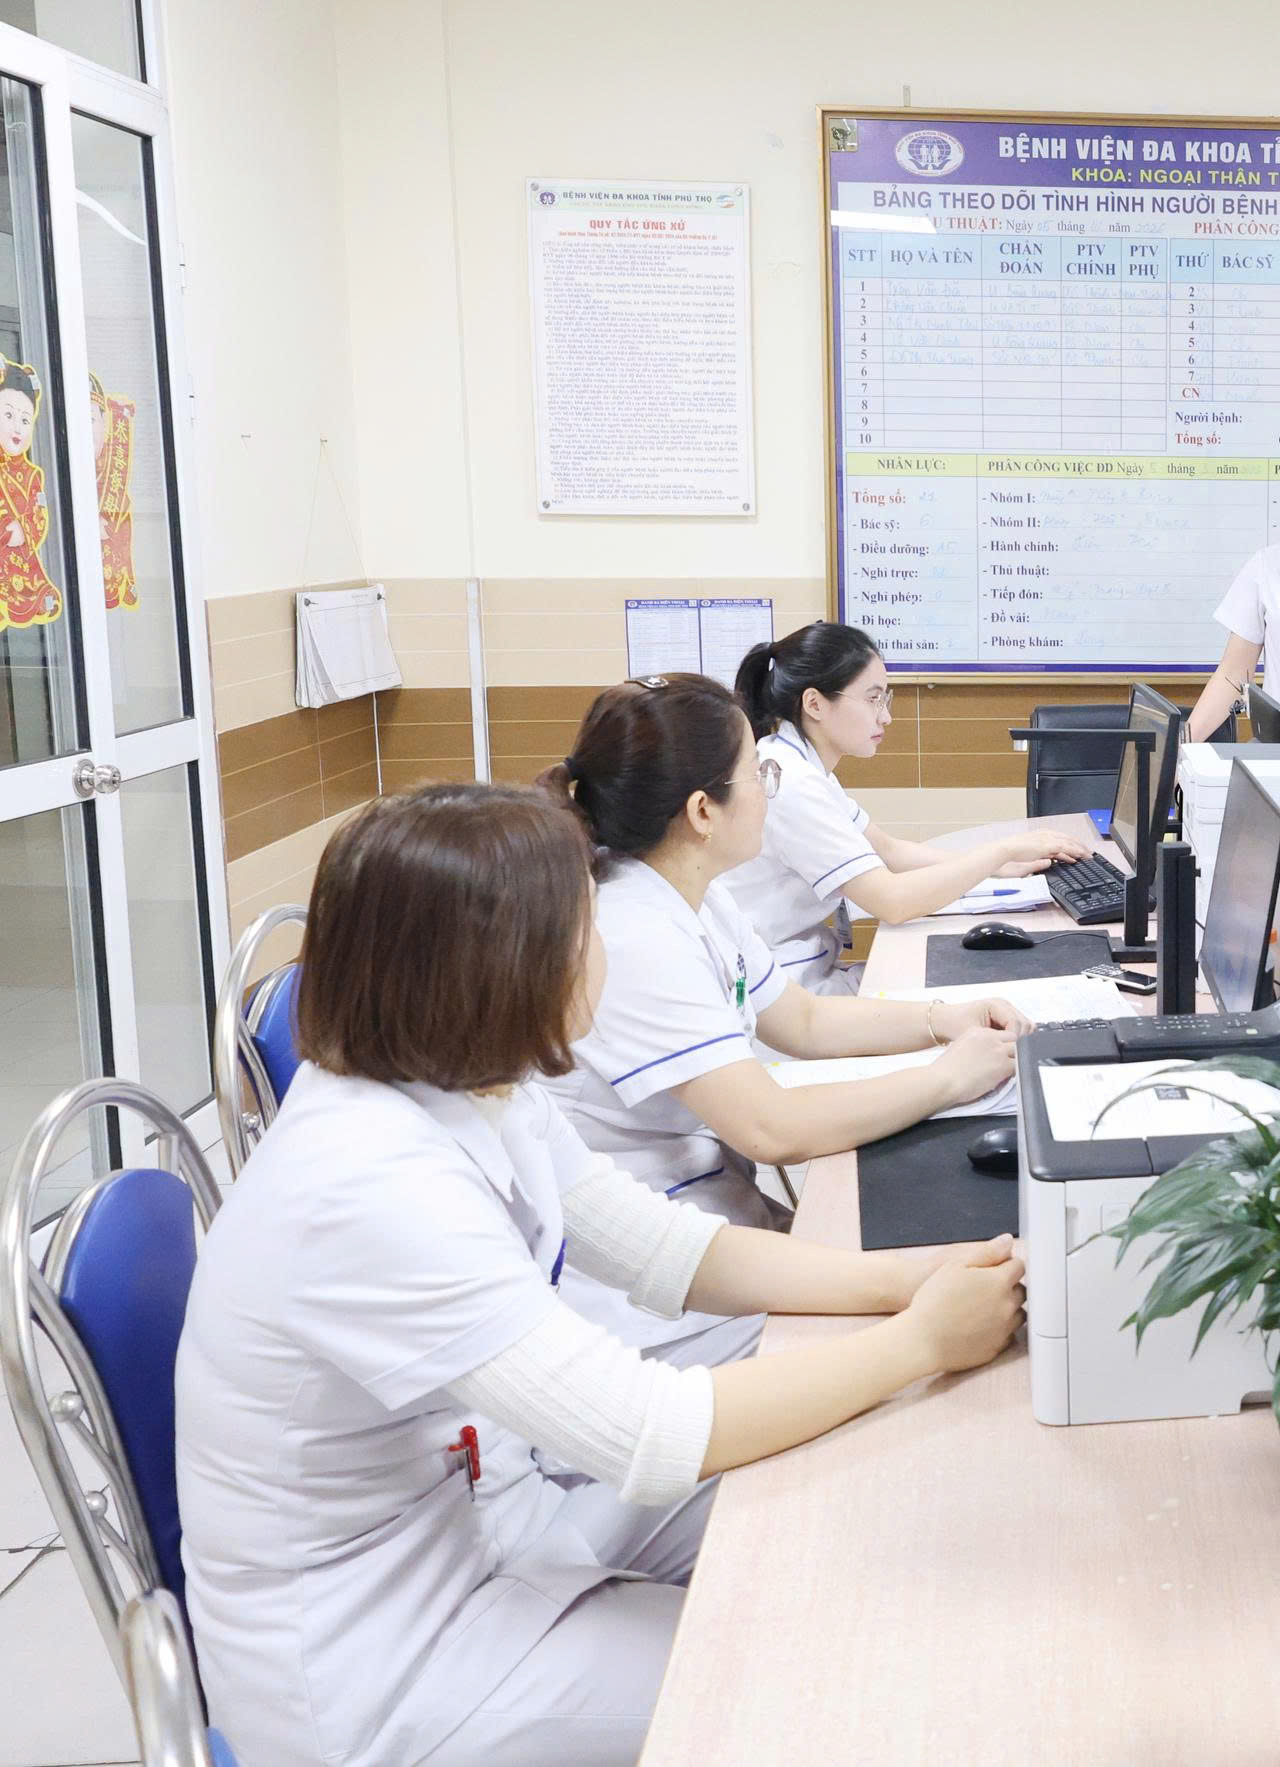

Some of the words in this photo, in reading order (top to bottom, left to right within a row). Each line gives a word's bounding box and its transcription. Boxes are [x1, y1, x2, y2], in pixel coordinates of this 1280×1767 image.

[999, 133, 1067, 164] BỆNH
[1076, 134, 1134, 165] VIỆN
[1142, 140, 1176, 161] ĐA
[1186, 141, 1253, 164] KHOA
[1071, 167, 1133, 183] KHOA:
[1139, 168, 1201, 186] NGOẠI
[1208, 168, 1261, 188] THẬN
[563, 191, 587, 201] BỆNH
[589, 192, 609, 201] VIỆN
[627, 194, 650, 202] KHOA
[696, 195, 713, 204] THỌ
[873, 184, 932, 210] BẢNG
[939, 191, 995, 210] THEO
[1001, 189, 1036, 211] DÕI
[1042, 190, 1089, 212] TÌNH
[1096, 190, 1144, 213] HÌNH
[1151, 193, 1215, 214] NGƯỜI
[1222, 194, 1278, 218] BỆNH
[589, 220, 612, 229] QUY
[642, 218, 666, 231] ỨNG
[670, 219, 687, 231] XỬ
[1006, 220, 1034, 233] Ngày
[1057, 220, 1086, 235] tháng
[1108, 222, 1131, 233] năm
[1194, 221, 1233, 235] PHÂN
[1237, 221, 1279, 236] CÔNG
[848, 248, 878, 262] STT
[890, 250, 913, 264] HỌ
[917, 247, 938, 263] VÀ
[944, 247, 974, 264] TÊN
[1077, 244, 1106, 257] PTV
[1130, 244, 1159, 257] PTV
[1000, 258, 1043, 275] ĐOÁN
[1176, 252, 1210, 268] THỨ
[1222, 252, 1254, 269] BÁC
[1256, 253, 1275, 270] SỸ
[1066, 259, 1116, 276] CHÍNH
[1129, 262, 1160, 279] PHỤ
[860, 281, 866, 291] 1
[1188, 286, 1195, 297] 2
[860, 298, 867, 309] 2
[1188, 303, 1195, 314] 3
[861, 315, 867, 326] 3
[1188, 320, 1195, 331] 4
[860, 332, 867, 343] 4
[1188, 337, 1195, 348] 5
[861, 349, 868, 360] 5
[1188, 354, 1195, 365] 6
[861, 366, 868, 377] 6
[1188, 371, 1195, 381] 7
[861, 383, 868, 393] 7
[1182, 387, 1200, 399] CN
[861, 400, 868, 410] 8
[861, 417, 868, 427] 9
[1175, 411, 1209, 426] Người
[1212, 411, 1243, 426] bệnh:
[859, 434, 872, 445] 10
[1174, 432, 1203, 447] Tổng
[1204, 432, 1222, 446] số:
[877, 458, 914, 471] NHÂN
[916, 459, 947, 473] LỰC:
[988, 459, 1023, 472] PHÂN
[1025, 460, 1061, 473] CÔNG
[1064, 461, 1095, 475] VIỆC
[1096, 463, 1115, 474] ĐD
[1117, 463, 1144, 477] Ngày
[1167, 462, 1196, 478] tháng
[1216, 464, 1239, 475] năm
[852, 489, 886, 507] Tổng
[888, 488, 907, 505] số:
[990, 491, 1024, 504] Nhóm
[1027, 493, 1036, 504] I:
[861, 518, 882, 531] Bác
[884, 519, 901, 533] sỹ:
[990, 515, 1024, 529] Nhóm
[1028, 517, 1041, 528] II:
[861, 541, 887, 555] Điều
[890, 543, 930, 557] dưỡng:
[990, 539, 1021, 553] Hành
[1024, 540, 1059, 553] chính:
[861, 567, 888, 581] Nghỉ
[891, 569, 919, 581] trực:
[991, 564, 1014, 577] Thủ
[1018, 564, 1050, 578] thuật:
[861, 591, 888, 605] Nghỉ
[891, 591, 923, 606] phép:
[990, 587, 1016, 602] Tiếp
[1019, 588, 1043, 600] đón:
[861, 615, 875, 626] Đi
[878, 615, 901, 628] học:
[991, 609, 1007, 623] Đồ
[1010, 611, 1030, 624] vải:
[891, 639, 913, 650] thai
[916, 639, 939, 650] sản:
[991, 636, 1026, 649] Phòng
[1029, 635, 1064, 648] khám:
